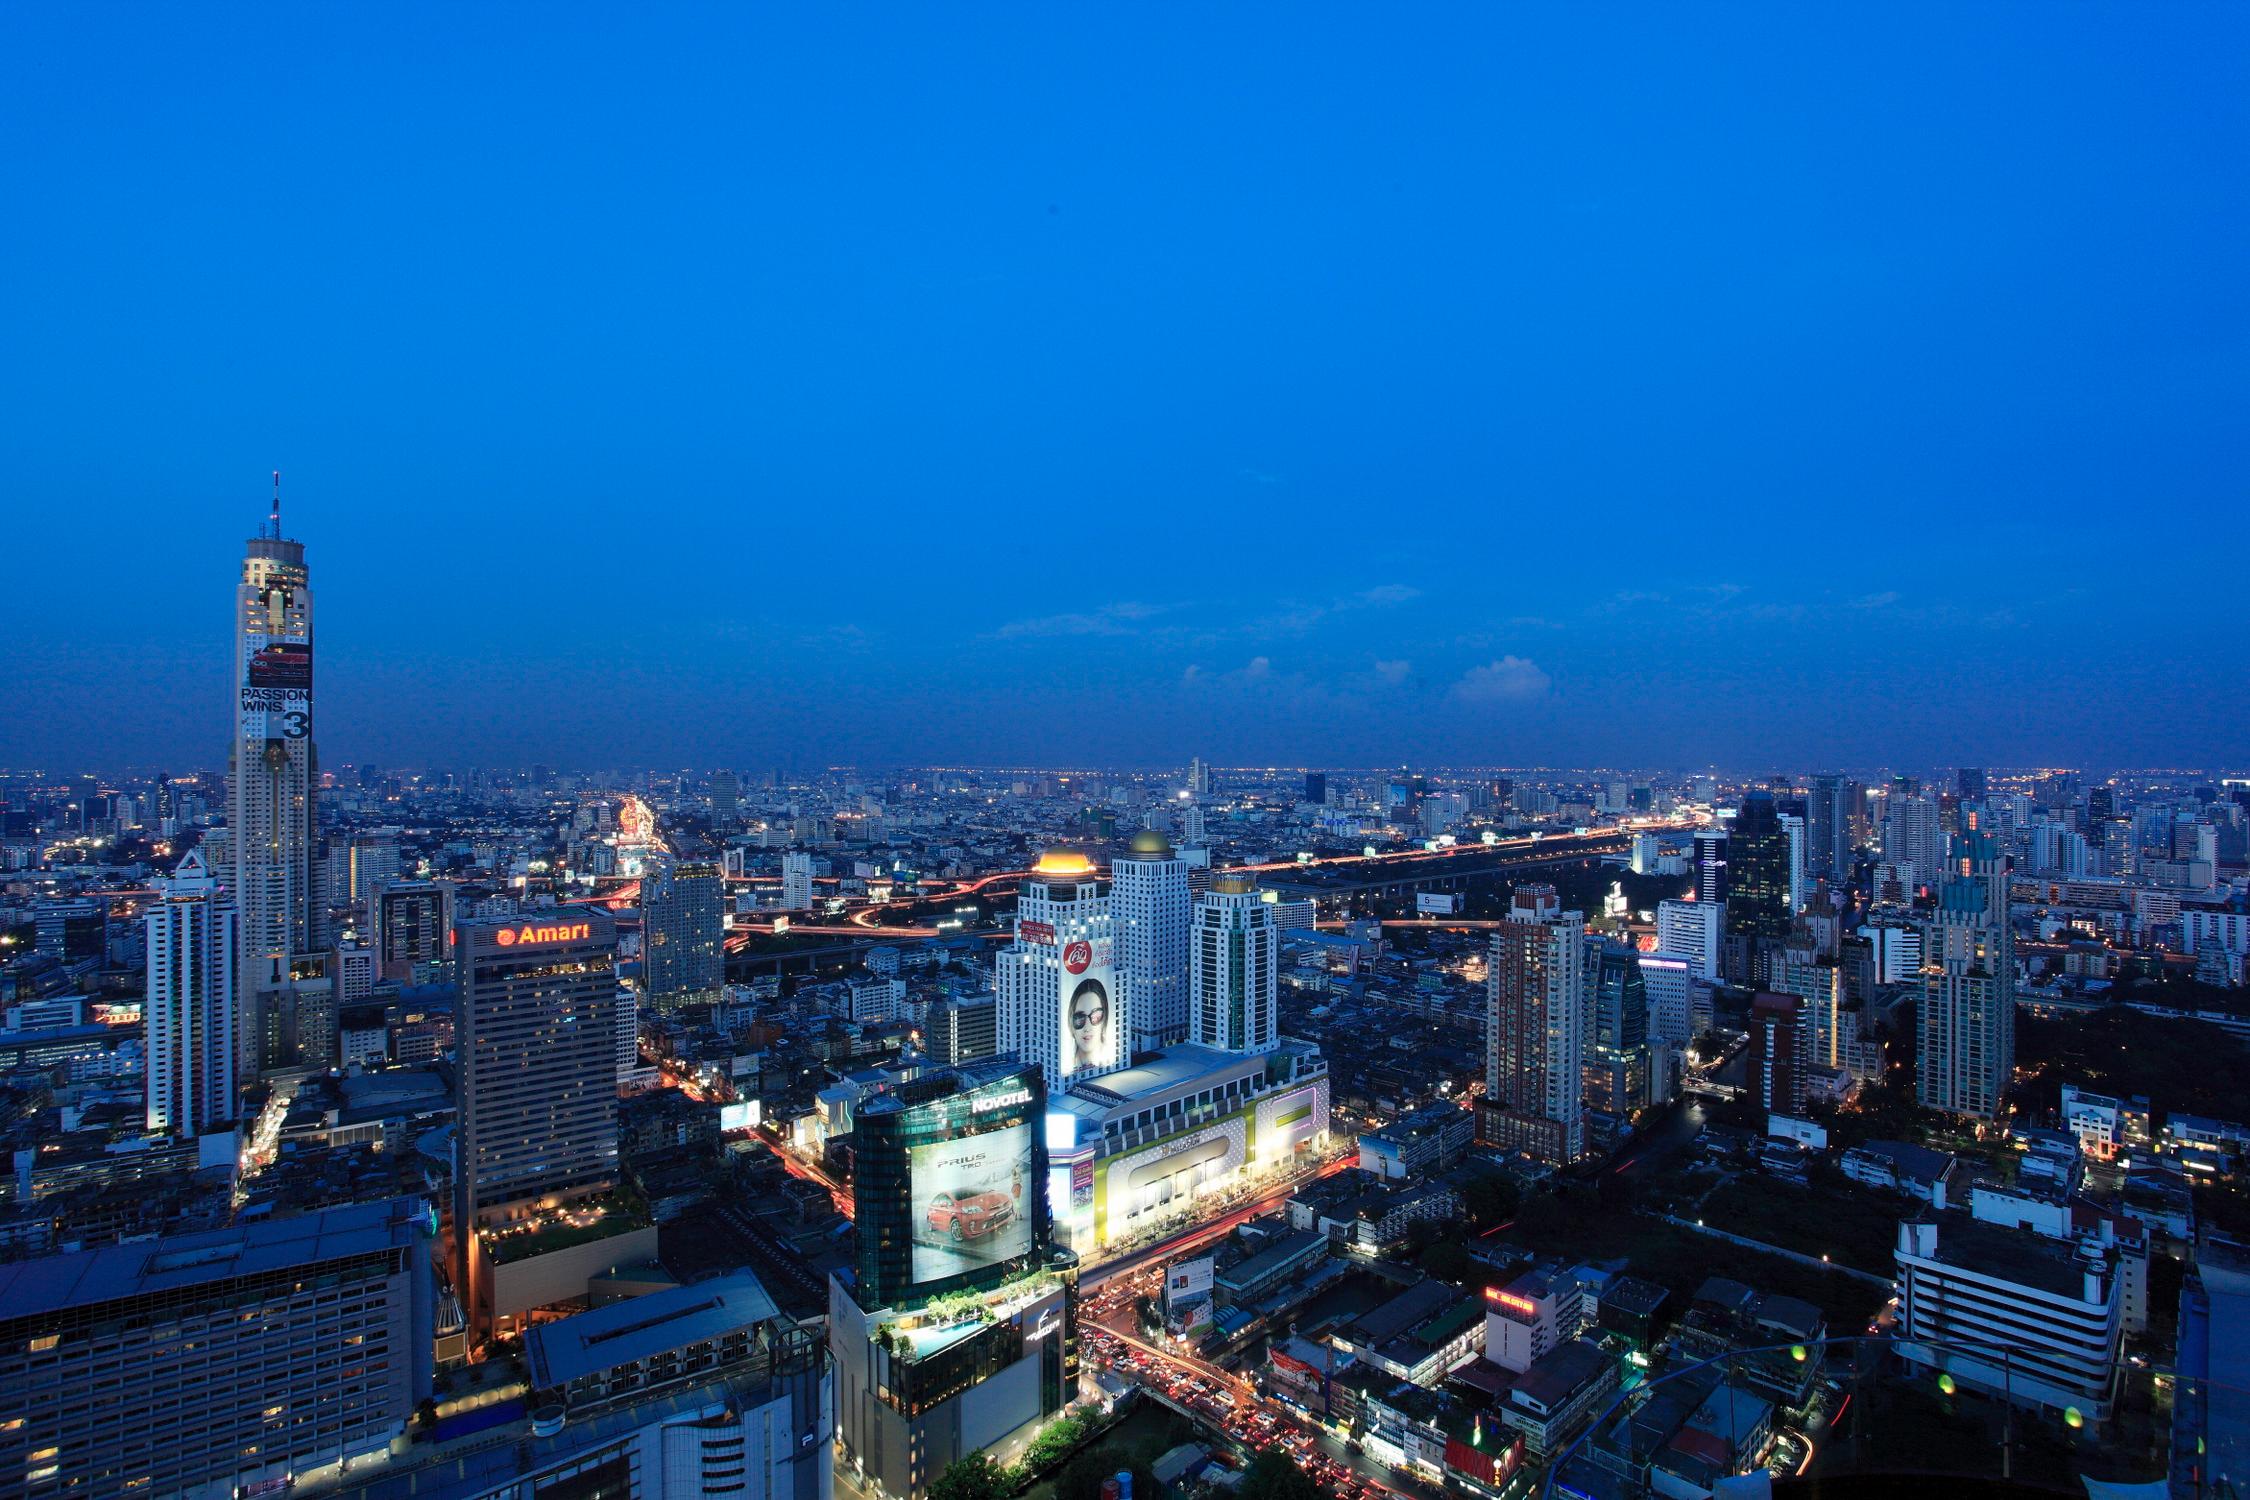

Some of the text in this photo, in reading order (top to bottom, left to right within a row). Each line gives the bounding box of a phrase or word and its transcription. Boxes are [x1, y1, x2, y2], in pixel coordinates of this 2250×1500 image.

[241, 688, 308, 701] PASSION
[242, 700, 286, 713] WINS.
[283, 711, 308, 739] 3
[1424, 896, 1430, 905] 5
[517, 922, 590, 945] Amari
[972, 1087, 1033, 1114] NOVOTEL
[937, 1152, 986, 1168] PRIUS
